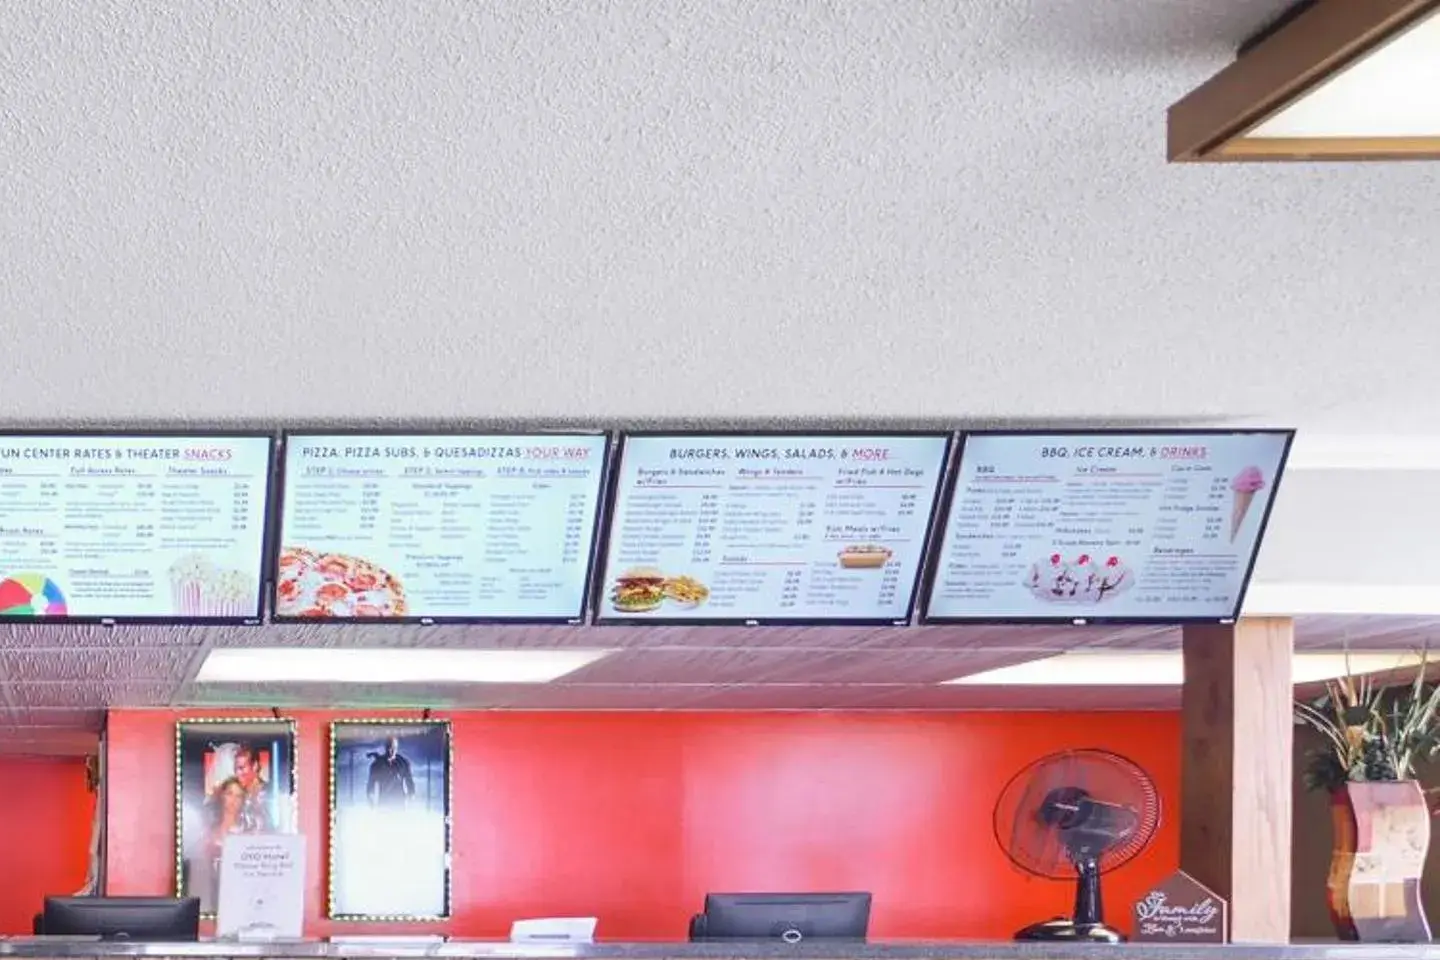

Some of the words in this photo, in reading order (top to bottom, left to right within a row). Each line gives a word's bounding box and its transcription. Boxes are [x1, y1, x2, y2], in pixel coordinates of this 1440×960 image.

[23, 448, 70, 459] CENTER
[74, 448, 112, 459] RATES
[115, 449, 122, 459] &
[127, 448, 180, 460] THEATER
[184, 448, 233, 461] SNACKS
[344, 447, 381, 459] PIZZA
[423, 448, 431, 459] &
[434, 447, 522, 459] QUESADIZZAS
[525, 447, 560, 459] YOUR
[563, 447, 591, 459] WAY
[669, 448, 730, 460] BURGERS,
[734, 448, 780, 460] WINGS,
[784, 448, 836, 460] SALADS,
[840, 448, 849, 460] &
[851, 448, 890, 461] MORE
[1073, 447, 1095, 459] ICE
[1097, 447, 1146, 459] CREAM,
[1150, 447, 1158, 459] &
[1160, 447, 1207, 459] DRINKS
